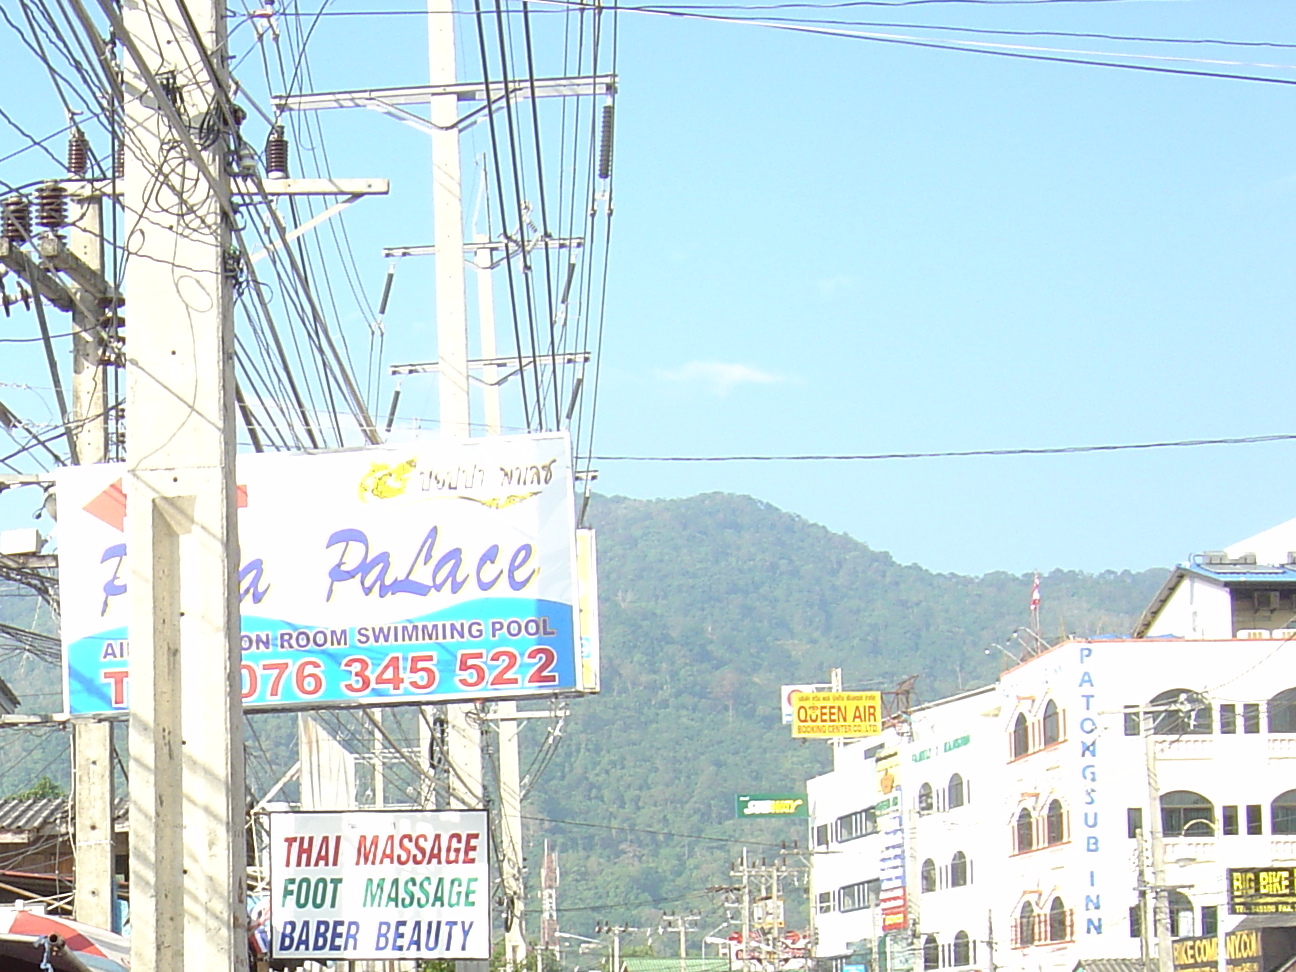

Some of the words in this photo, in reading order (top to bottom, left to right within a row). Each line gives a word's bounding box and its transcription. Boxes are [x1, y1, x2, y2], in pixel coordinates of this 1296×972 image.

[280, 629, 348, 650] ROOM
[357, 621, 484, 645] SWIMMING
[491, 617, 556, 639] POOL
[241, 660, 324, 698] 076
[344, 654, 437, 693] 345
[459, 646, 557, 688] 522
[797, 705, 848, 723] QUEEN
[852, 704, 877, 723] AIR
[284, 835, 342, 868] THAI
[355, 832, 480, 866] MASSAGE
[281, 877, 343, 909] FOOT
[363, 876, 479, 909] MASSAGE
[1259, 871, 1290, 895] BIKE
[279, 920, 360, 951] BABER
[374, 920, 475, 951] BEAUTY
